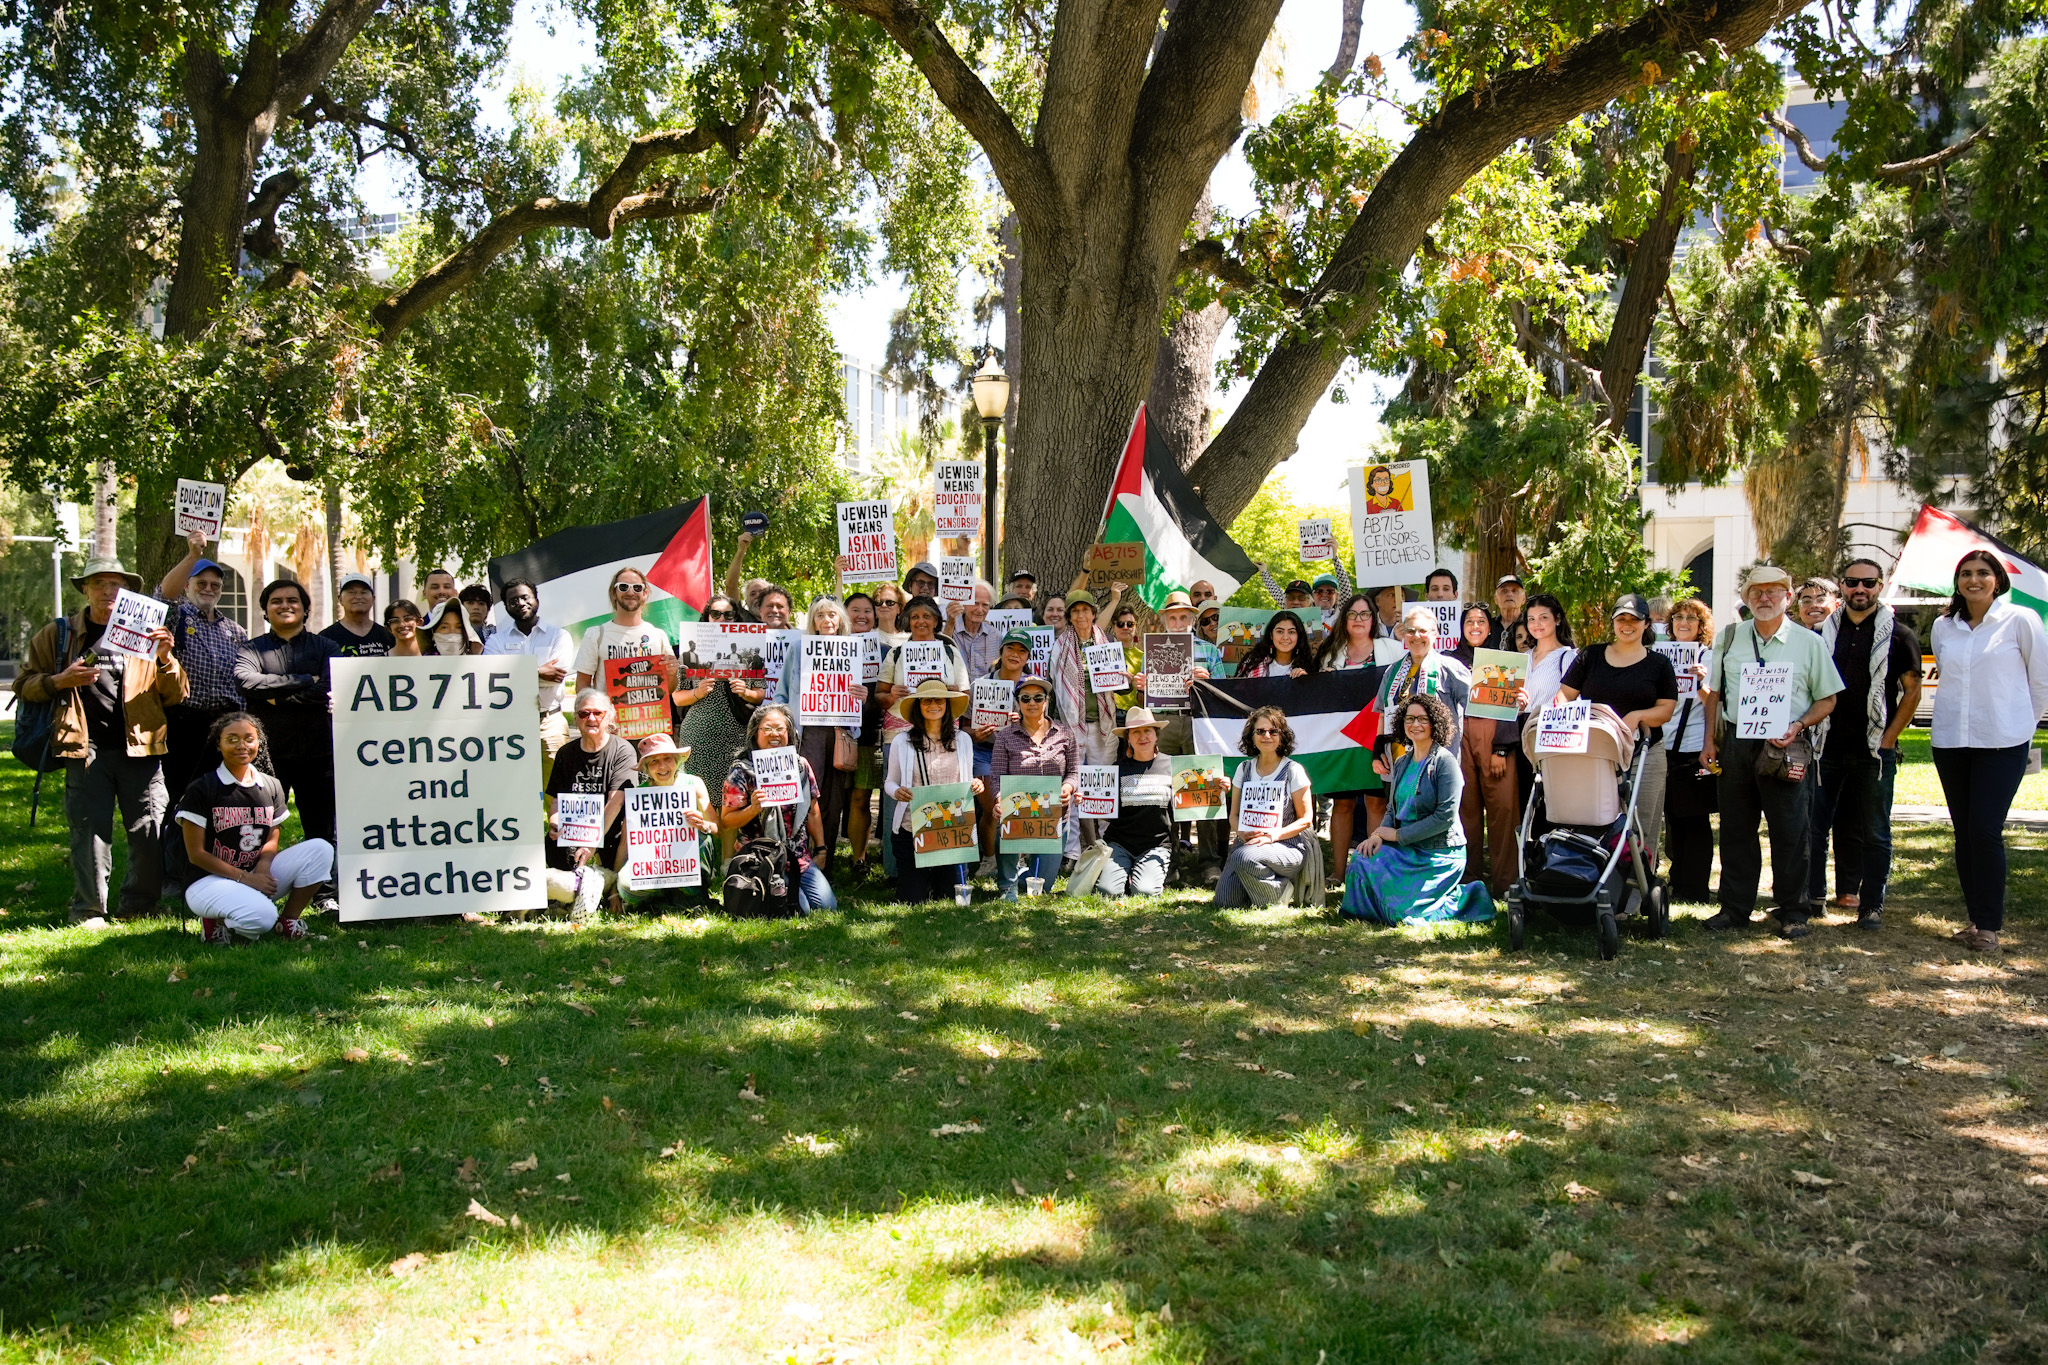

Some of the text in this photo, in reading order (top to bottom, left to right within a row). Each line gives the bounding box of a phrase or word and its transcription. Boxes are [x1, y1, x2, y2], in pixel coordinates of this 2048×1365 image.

[938, 466, 979, 479] JEWISH
[1388, 462, 1410, 470] CENSORED
[944, 480, 974, 492] MEANS
[180, 488, 222, 508] EDUCATION
[936, 494, 981, 504] EDUCATION
[842, 505, 888, 521] JEWISH
[954, 506, 966, 516] NOT
[848, 520, 882, 534] MEANS
[938, 518, 978, 528] CENSORSHIP
[1300, 524, 1329, 538] EDUCATION
[848, 534, 886, 554] ASKING
[1364, 531, 1420, 548] CENSORS
[1362, 544, 1431, 567] TEACHERS
[942, 562, 974, 576] EDUCATION
[1092, 568, 1144, 584] CENSORSHIP
[941, 586, 972, 601] CENSORSHIP
[116, 597, 164, 626] EDUCATION
[720, 624, 766, 634] TEACH
[108, 626, 153, 654] CENSORSHIP
[359, 642, 376, 650] Jewish
[806, 640, 858, 657] JEWISH
[906, 647, 941, 662] EDUCATION
[1089, 648, 1122, 665] EDUCATION
[630, 660, 648, 674] STOP
[686, 668, 766, 678] PALESTINE
[812, 658, 850, 672] MEANS
[1742, 667, 1789, 676] A JEWISH
[626, 674, 658, 688] ARMING
[1094, 672, 1124, 688] CENSORSHIP
[1150, 675, 1187, 683] JEWS SAY
[1746, 677, 1786, 685] TEACHER
[350, 672, 514, 712] AB 715
[627, 688, 660, 704] ISRAEL
[976, 686, 1011, 702] EDUCATION
[1489, 689, 1498, 703] AB
[1501, 690, 1518, 705] 715
[1741, 694, 1786, 706] NO ON
[802, 694, 860, 713] QUESTIONS
[618, 704, 663, 722] END THE
[975, 710, 1008, 727] CENSORSHIP
[1542, 706, 1586, 721] EDUCATION
[1743, 722, 1772, 736] 715
[356, 734, 526, 766] censors
[756, 754, 794, 774] EDUCATION
[408, 769, 469, 800] and
[572, 783, 603, 792] RESIST
[1080, 772, 1115, 788] EDUCATION
[632, 792, 690, 811] JEWISH
[1192, 793, 1202, 805] AB
[1205, 790, 1220, 806] 715
[1245, 787, 1282, 802] EDUCATION
[562, 800, 601, 815] EDUCATION
[1081, 799, 1114, 814] CENSORSHIP
[212, 806, 254, 833] CHANNEL
[640, 811, 683, 828] MEANS
[362, 808, 520, 850] attacks
[562, 824, 599, 841] CENSORSHIP
[630, 827, 696, 845] EDUCATION
[1022, 820, 1035, 836] AB
[1037, 820, 1056, 837] 715
[937, 832, 949, 847] AB
[951, 827, 971, 846] 715
[655, 844, 672, 859] NOT
[632, 858, 696, 876] CENSORSHIP
[356, 862, 532, 900] teachers
